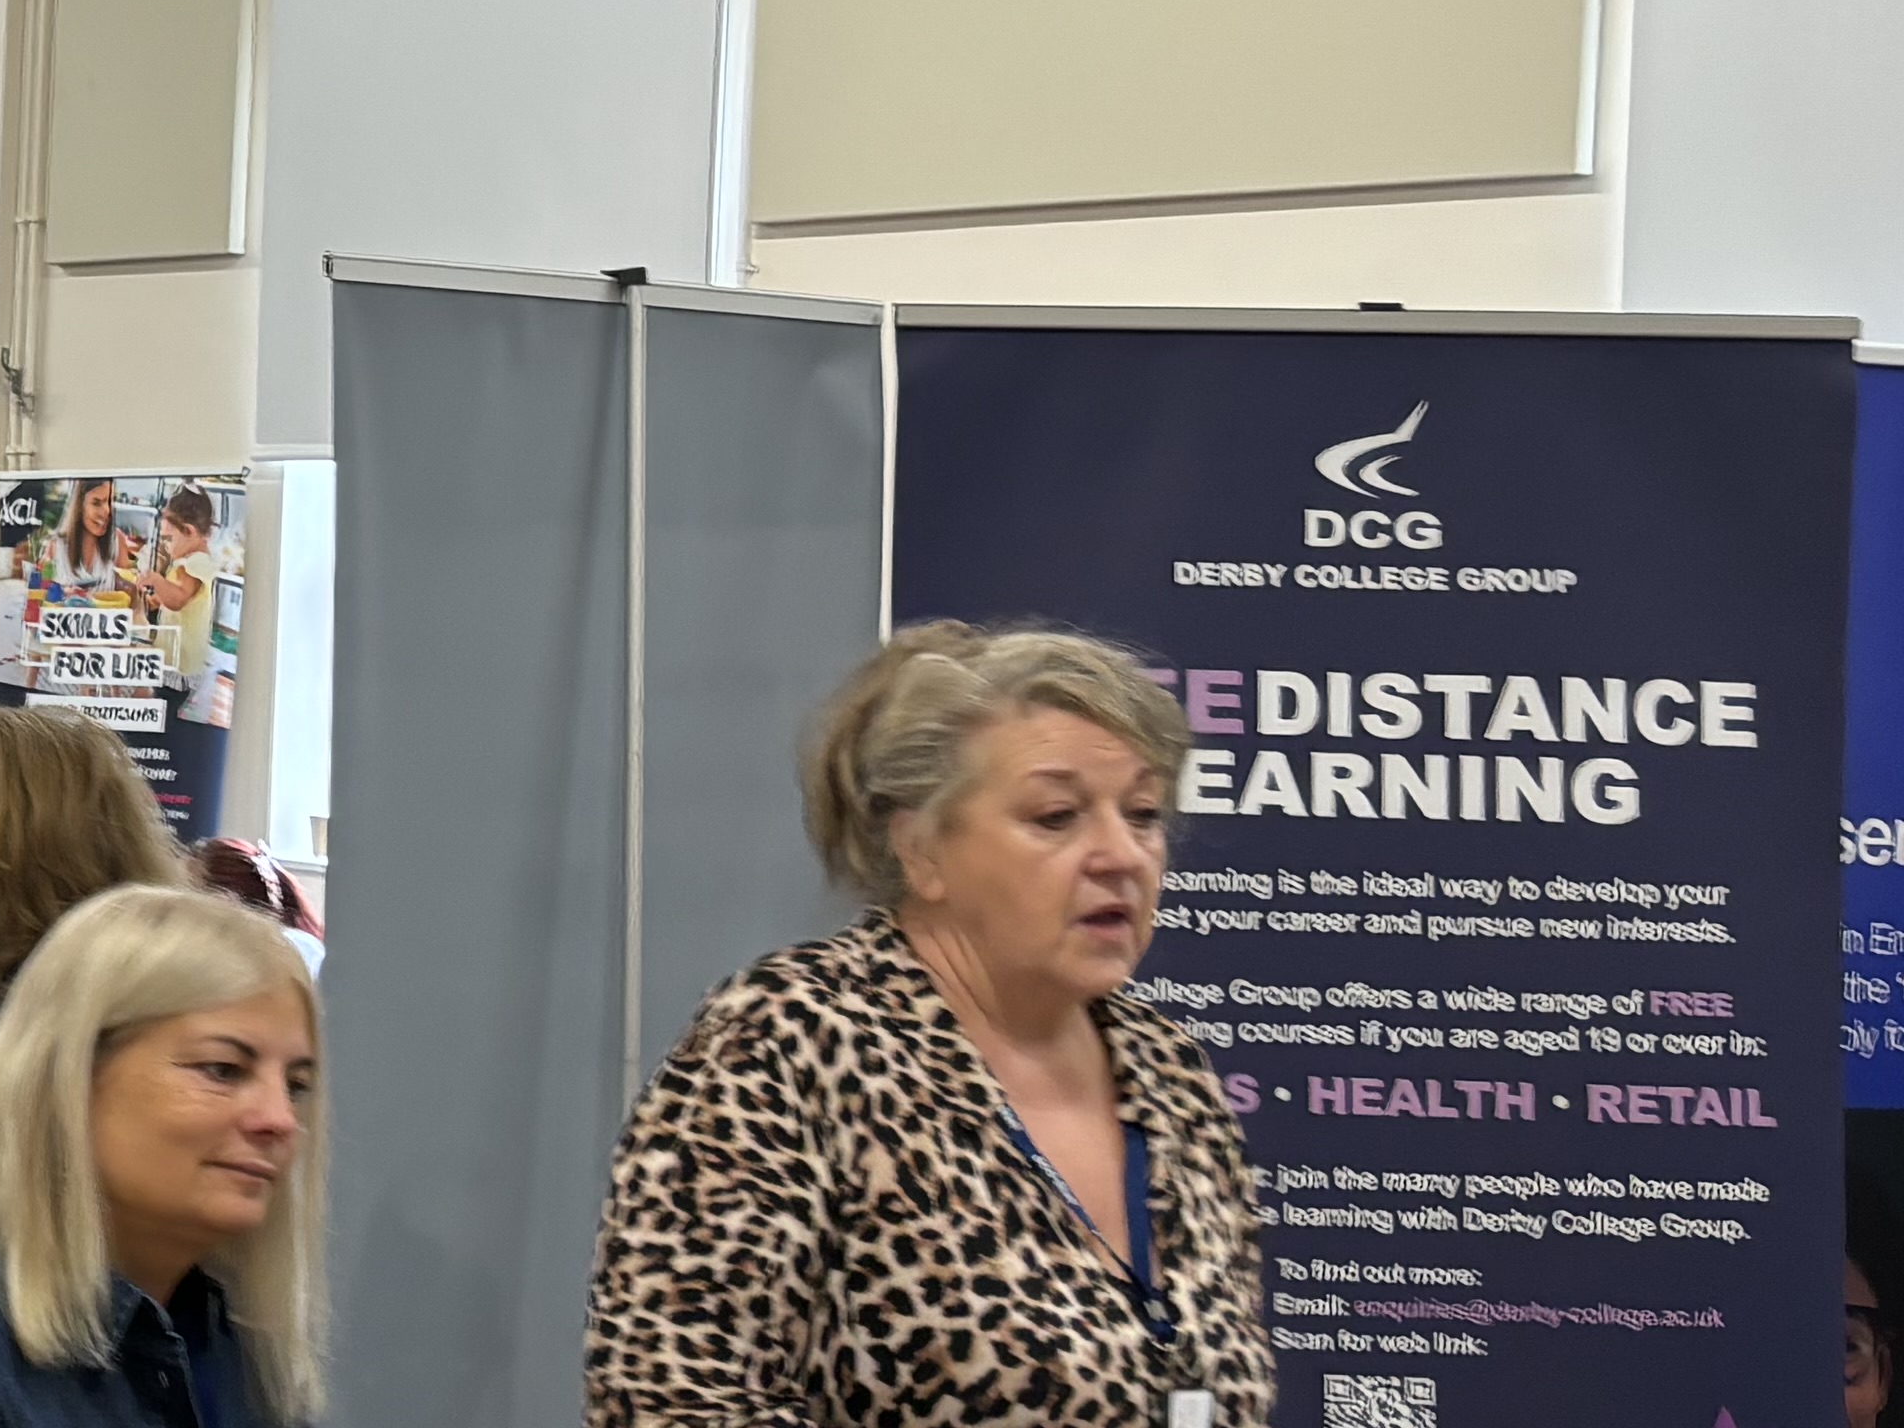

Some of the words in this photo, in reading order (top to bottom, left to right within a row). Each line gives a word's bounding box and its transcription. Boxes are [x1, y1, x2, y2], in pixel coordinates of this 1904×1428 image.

[0, 496, 43, 528] ACL
[1303, 508, 1444, 550] DCG
[1173, 560, 1286, 591] DERBY
[1294, 564, 1449, 592] COLLEGE
[1456, 567, 1579, 594] GROUP
[40, 611, 130, 642] SKILLS
[54, 651, 106, 680] FOR
[110, 653, 163, 682] LIFE
[1256, 668, 1759, 748] DISTANCE
[1177, 748, 1642, 825] EARNING
[1162, 866, 1273, 900] earning
[1278, 868, 1307, 896] is
[1309, 869, 1359, 897] the
[1362, 870, 1435, 899] ideal
[1439, 877, 1503, 906] way
[1507, 876, 1541, 901] to
[1545, 875, 1662, 909] develop
[1662, 882, 1731, 911] your
[1194, 908, 1264, 936] your
[1266, 909, 1361, 933] career
[1362, 909, 1423, 935] and
[1427, 915, 1536, 942] pursue
[1539, 917, 1605, 941] new
[1605, 914, 1738, 944] interests.
[1228, 978, 1322, 1013] Group
[1325, 981, 1413, 1010] offers
[1416, 989, 1438, 1010] a
[1442, 985, 1517, 1012] wide
[1520, 991, 1608, 1021] range
[1611, 989, 1645, 1016] of
[1649, 989, 1735, 1018] FREE
[1237, 1021, 1356, 1046] courses
[1359, 1020, 1384, 1047] if
[1385, 1025, 1444, 1053] you
[1448, 1027, 1499, 1050] are
[1503, 1025, 1581, 1057] aged
[1585, 1025, 1623, 1054] 19
[1625, 1033, 1660, 1055] or
[1661, 1033, 1727, 1056] over
[1729, 1029, 1769, 1057] in:
[1306, 1074, 1537, 1123] HEALTH
[1585, 1082, 1779, 1128] RETAIL
[1272, 1163, 1330, 1194] join
[1332, 1165, 1379, 1192] the
[1381, 1171, 1462, 1200] many
[1463, 1171, 1561, 1201] people
[1563, 1173, 1626, 1199] who
[1629, 1173, 1695, 1201] have
[1697, 1176, 1771, 1203] made
[1282, 1201, 1395, 1235] learning
[1396, 1205, 1459, 1232] with
[1462, 1206, 1548, 1240] Derby
[1551, 1209, 1658, 1243] College
[1659, 1212, 1752, 1245] Group.
[1273, 1257, 1308, 1282] To
[1310, 1258, 1361, 1283] find
[1362, 1262, 1408, 1286] out
[1408, 1267, 1483, 1287] more:
[1272, 1291, 1351, 1317] Email:
[1271, 1325, 1336, 1352] Scan
[1337, 1328, 1373, 1352] for
[1375, 1330, 1431, 1355] web
[1432, 1331, 1489, 1356] link:
